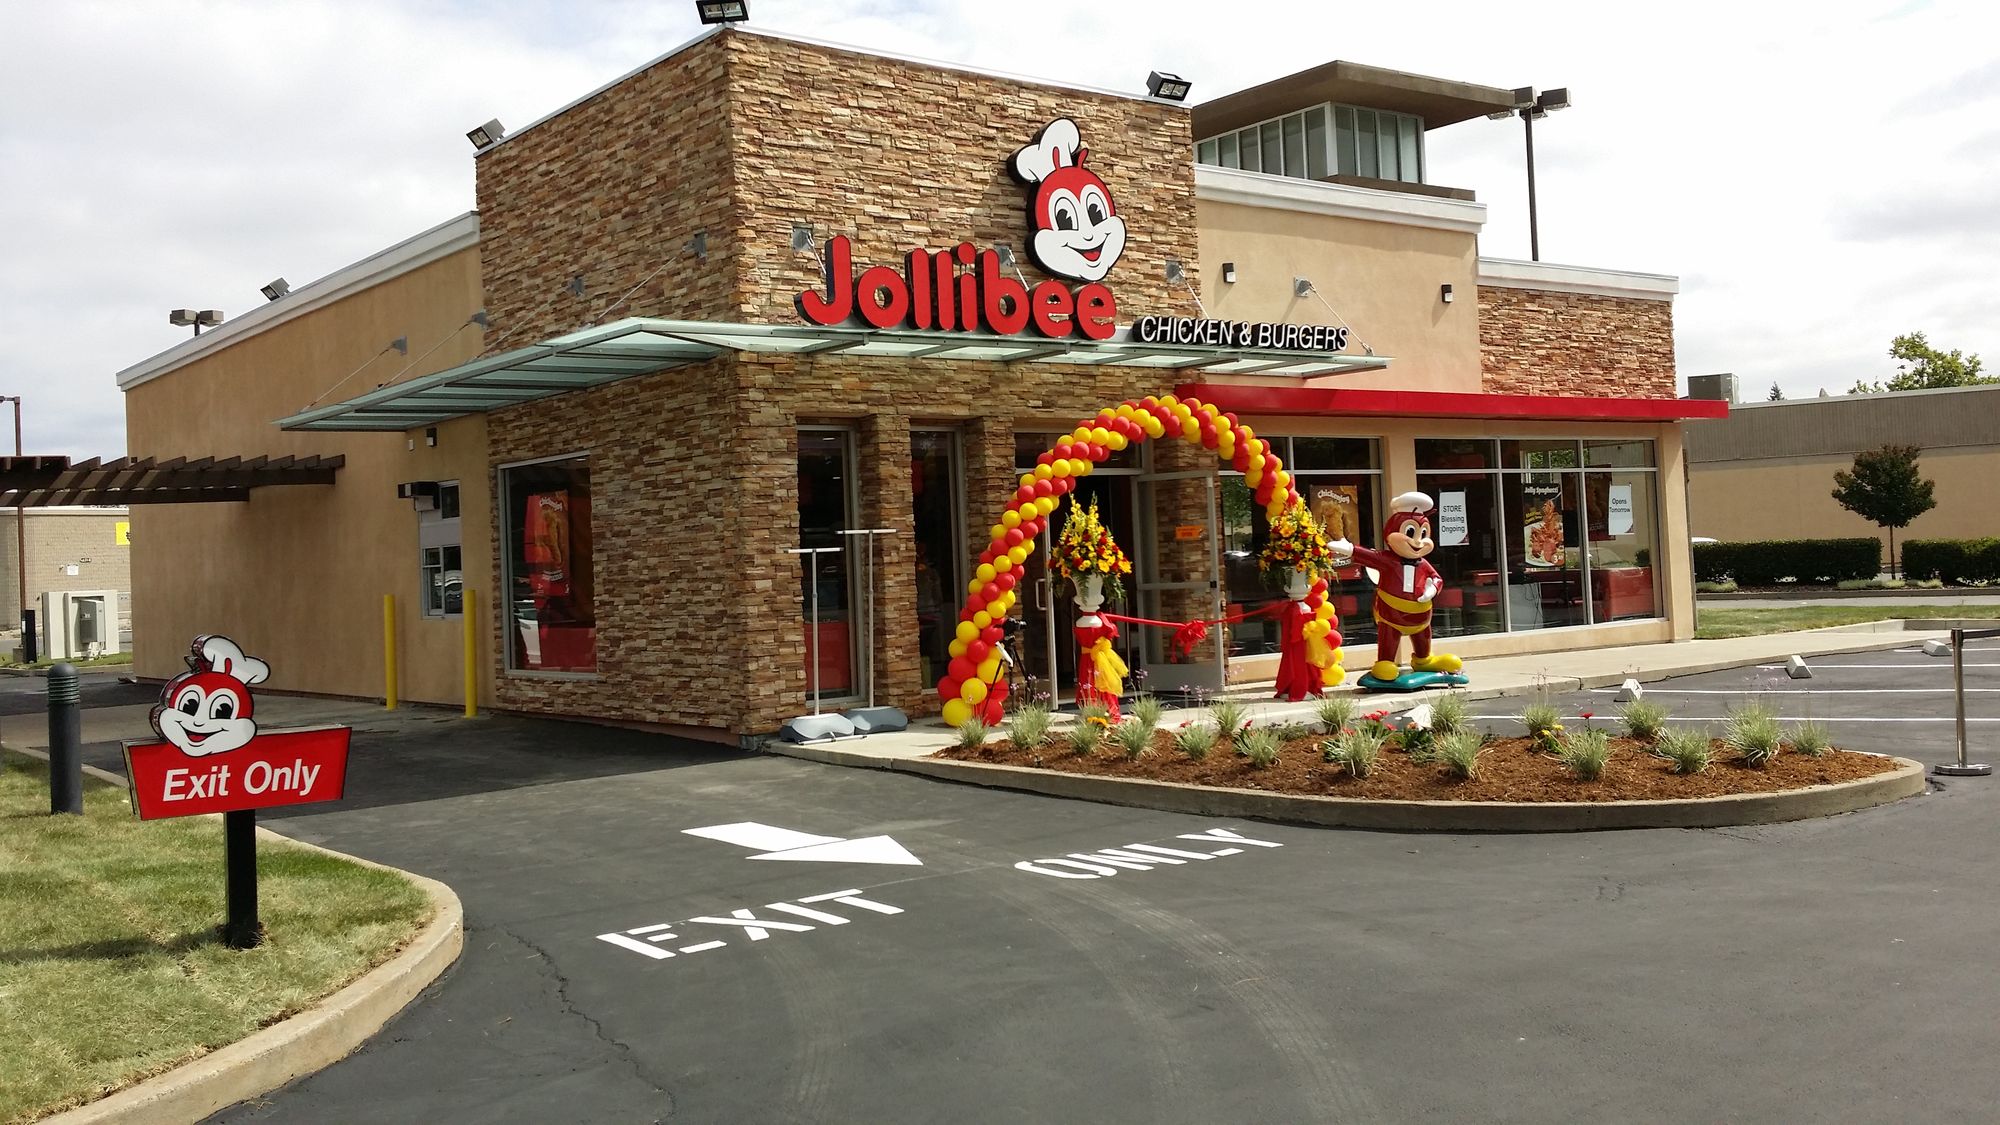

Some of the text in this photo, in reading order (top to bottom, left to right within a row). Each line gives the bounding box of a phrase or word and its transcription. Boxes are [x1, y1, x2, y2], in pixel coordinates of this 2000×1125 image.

[795, 235, 1117, 340] Jollibee
[1140, 315, 1349, 350] CHICKEN & BURGERS
[1317, 489, 1351, 504] Chickenjoy
[162, 758, 322, 802] Exit Only
[1014, 828, 1285, 880] ONLY
[595, 888, 905, 960] EXIT
